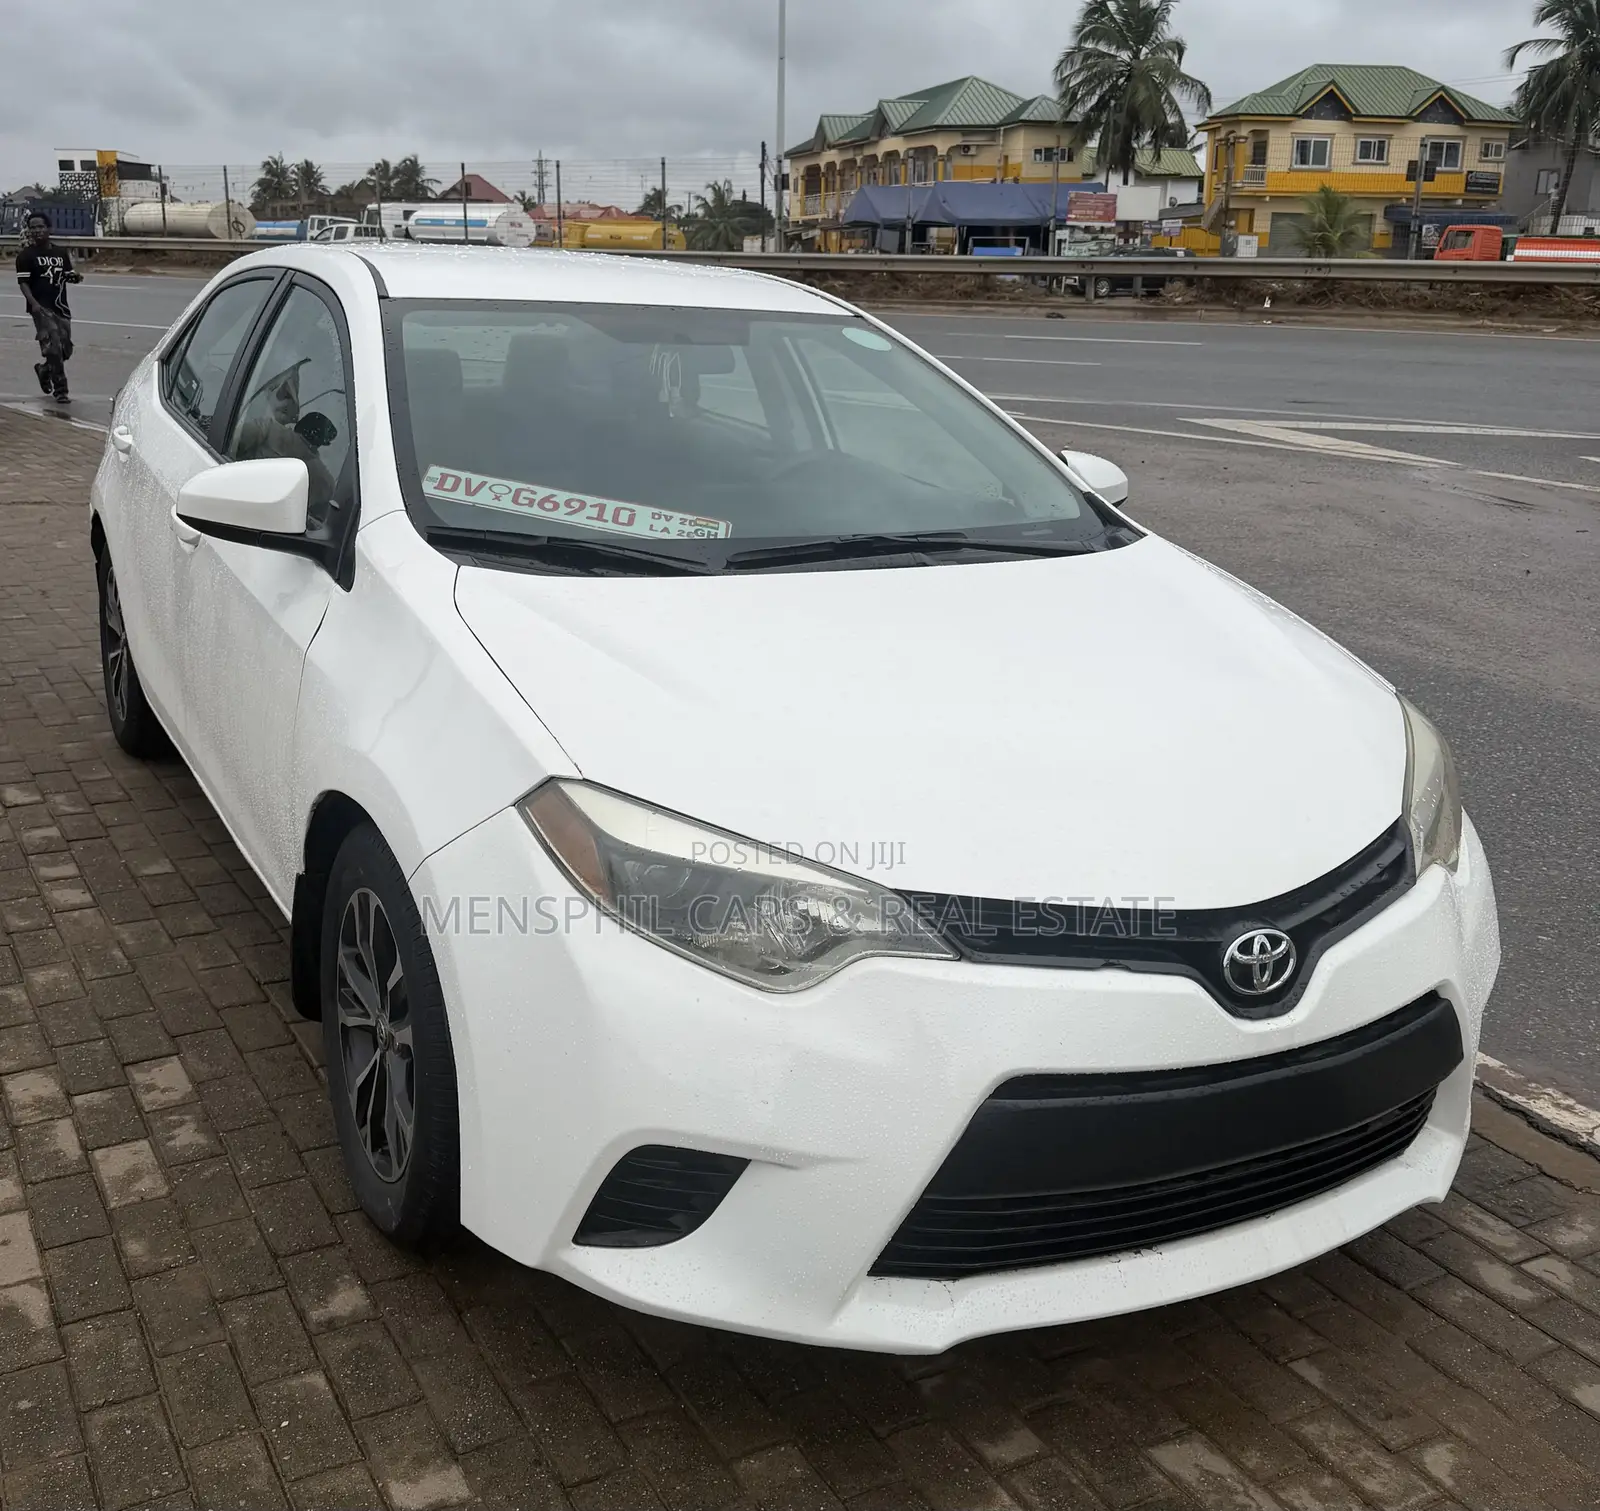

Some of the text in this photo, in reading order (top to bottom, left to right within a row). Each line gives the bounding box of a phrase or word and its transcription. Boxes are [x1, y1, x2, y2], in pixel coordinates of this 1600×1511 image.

[37, 256, 64, 267] DIOR
[433, 472, 637, 527] DV G6910
[651, 511, 674, 522] DV
[649, 523, 671, 535] LA
[694, 528, 719, 540] GH
